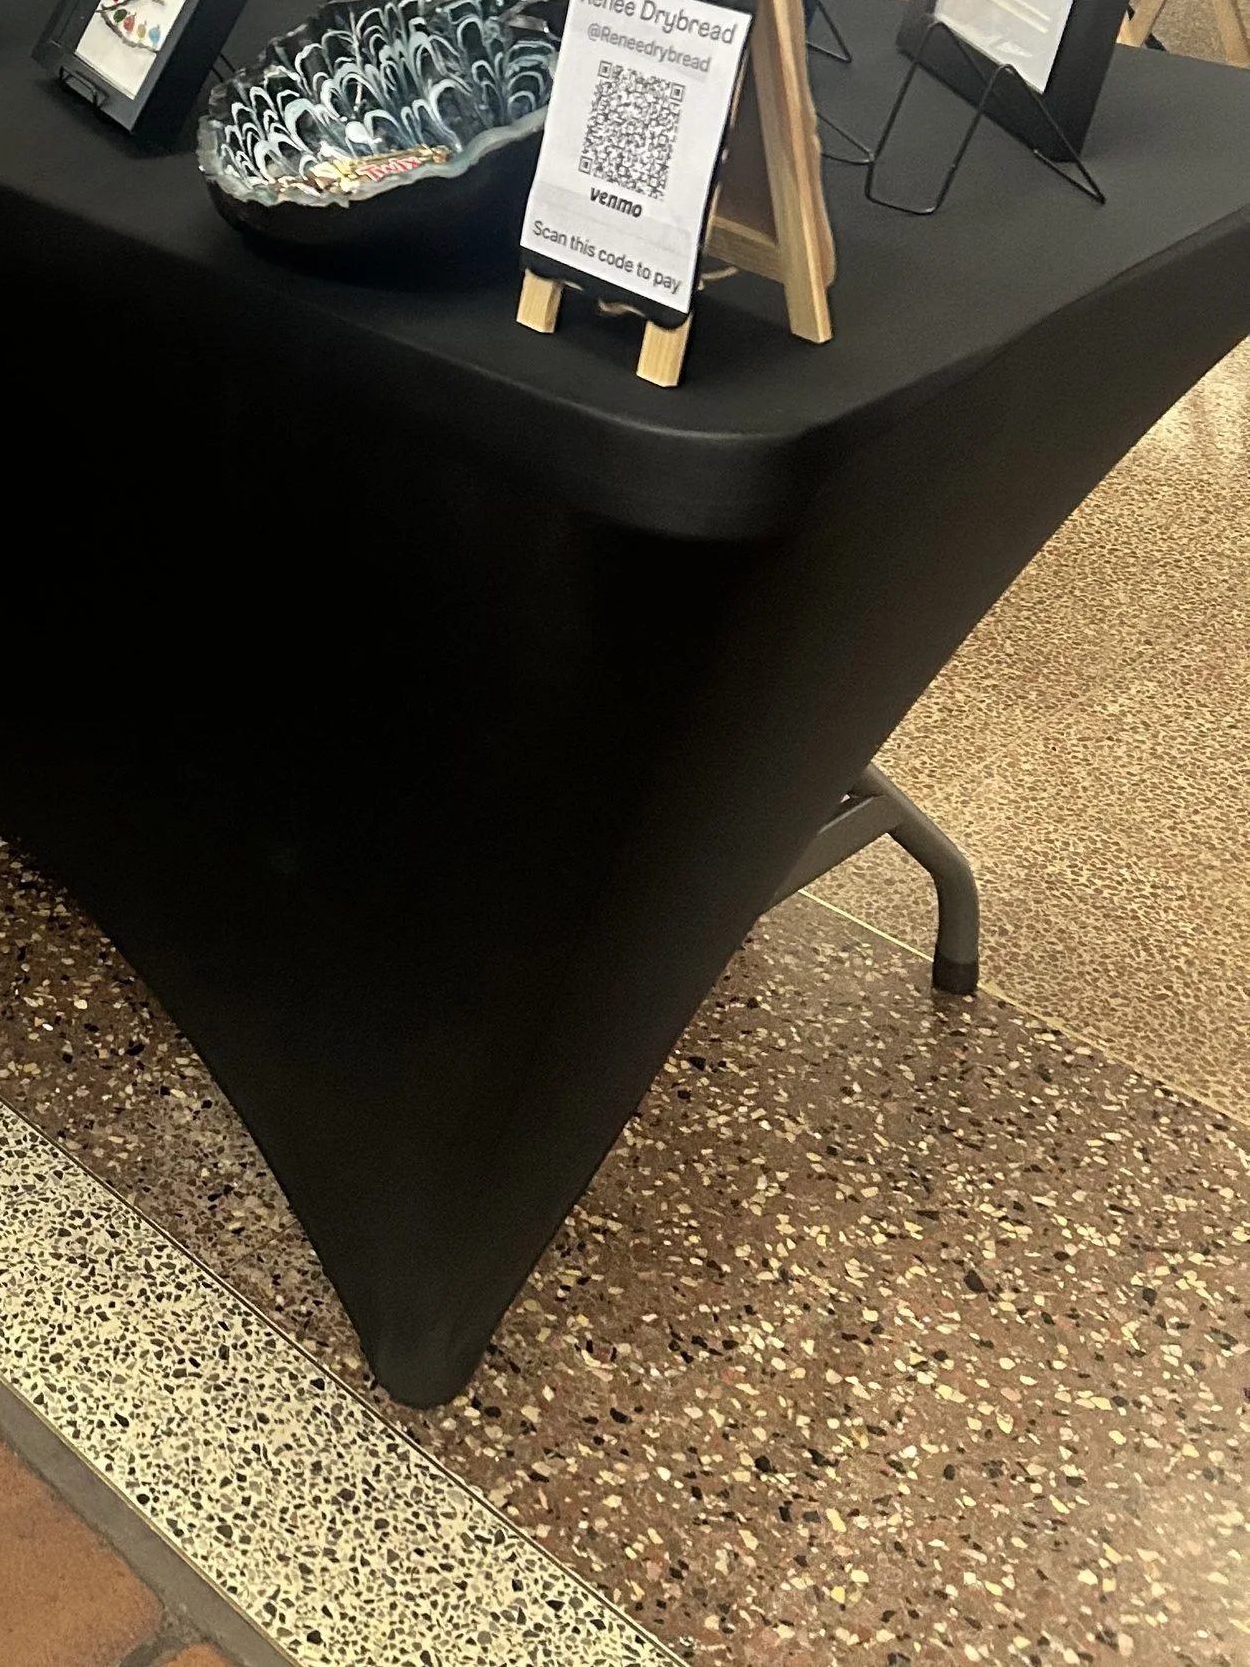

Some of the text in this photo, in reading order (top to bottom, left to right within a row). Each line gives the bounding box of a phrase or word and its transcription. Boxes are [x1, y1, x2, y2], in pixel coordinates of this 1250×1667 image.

[640, 0, 738, 45] Drybread
[588, 23, 712, 73] @Reneedrybread
[590, 187, 643, 218] venmo
[532, 220, 682, 294] Scan this code to pay
